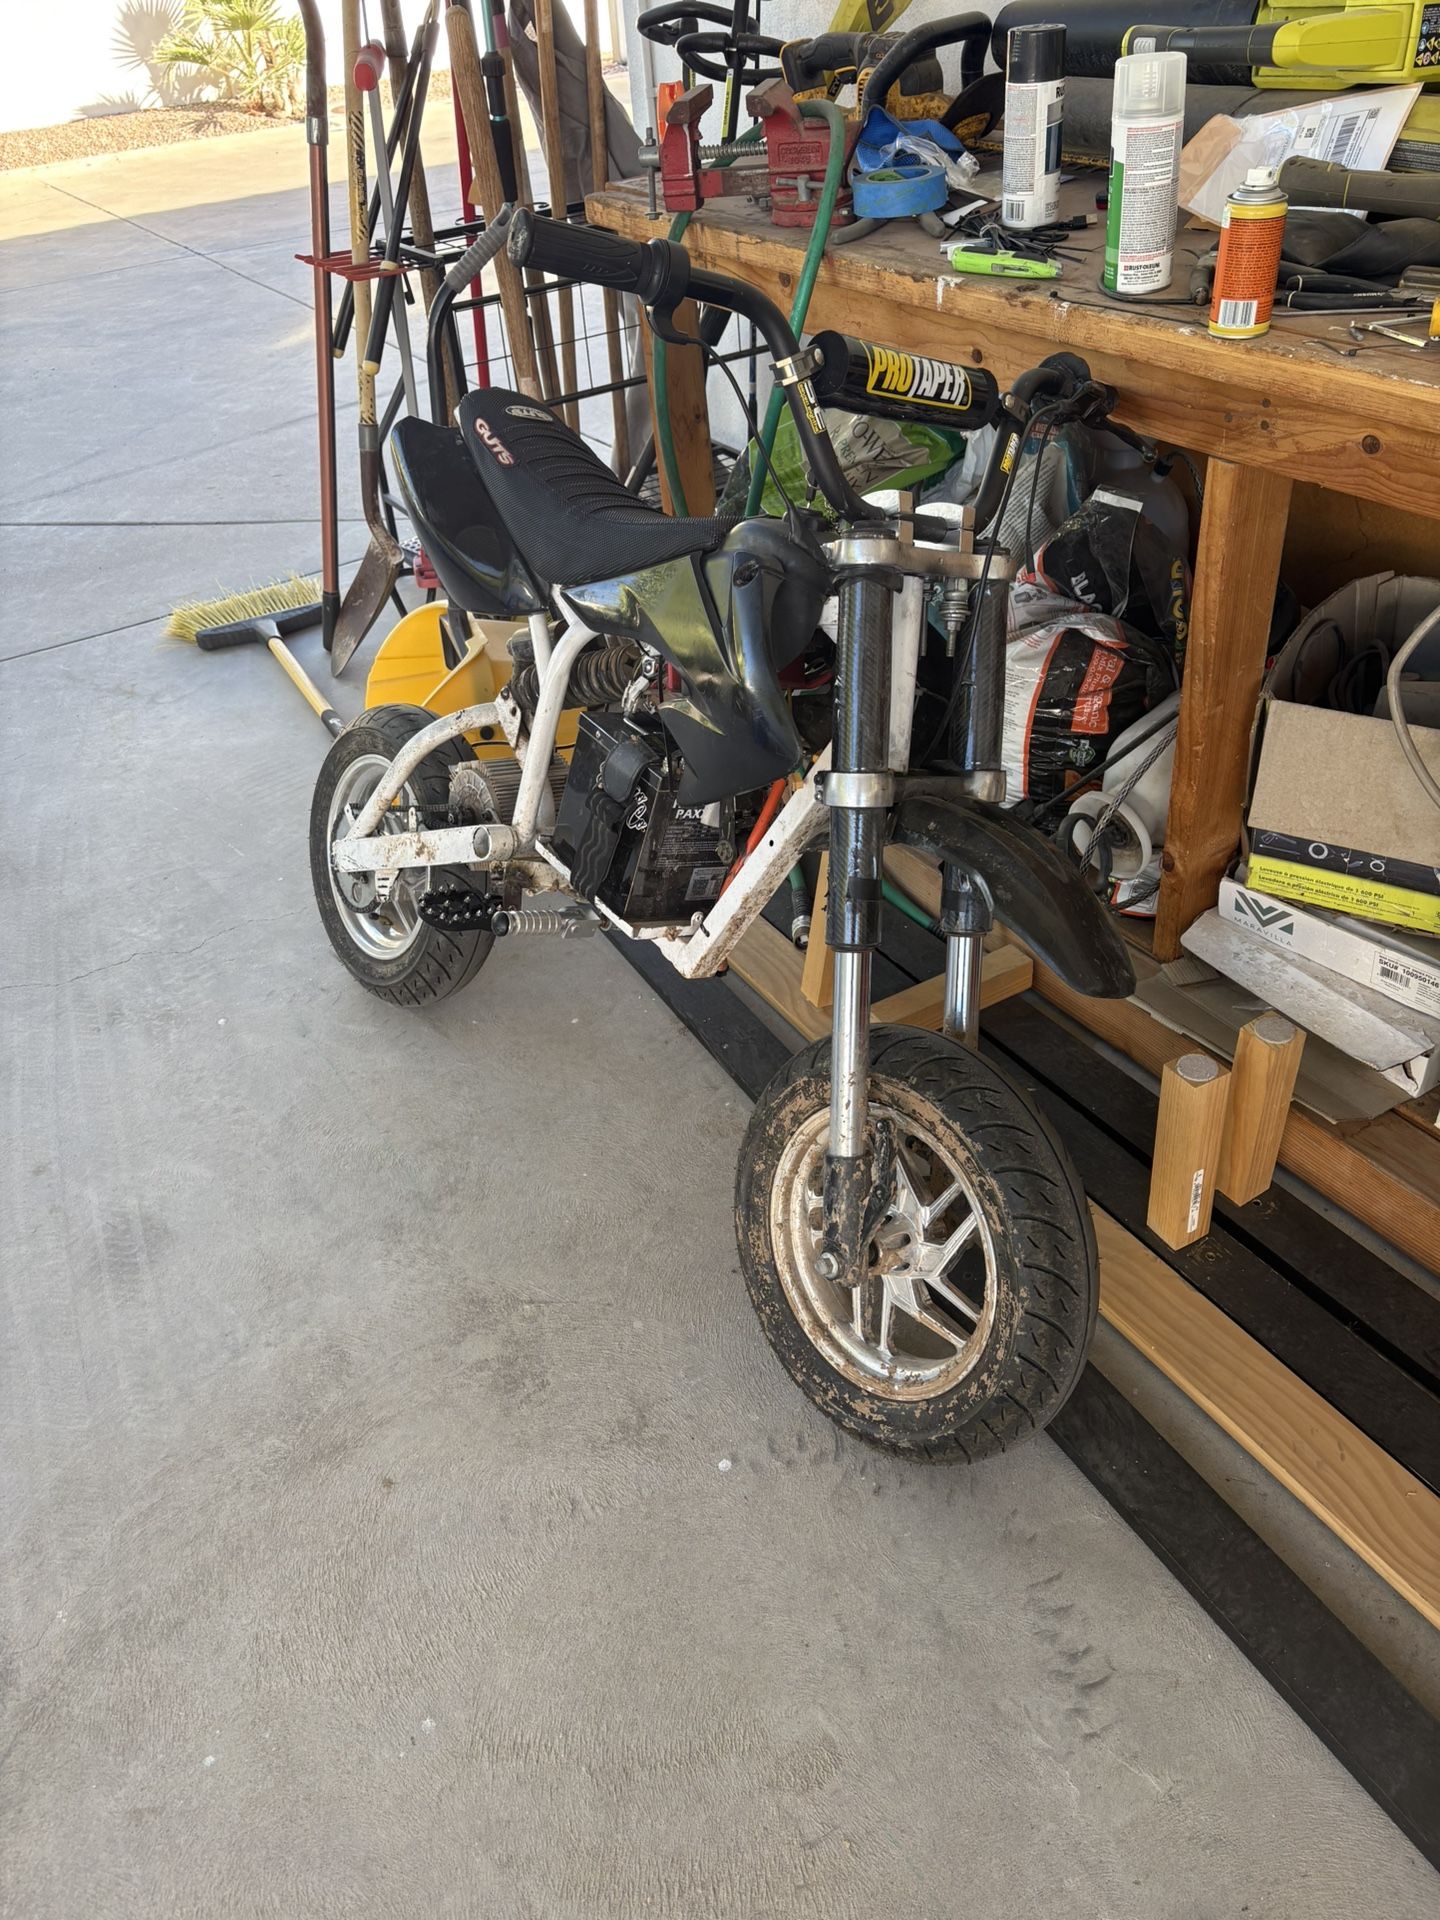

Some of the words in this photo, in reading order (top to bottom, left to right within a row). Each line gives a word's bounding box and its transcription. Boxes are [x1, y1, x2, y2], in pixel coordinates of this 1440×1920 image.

[475, 418, 514, 464] GUTS
[1234, 916, 1291, 946] MARAVILLA
[1378, 958, 1398, 971] SKU#
